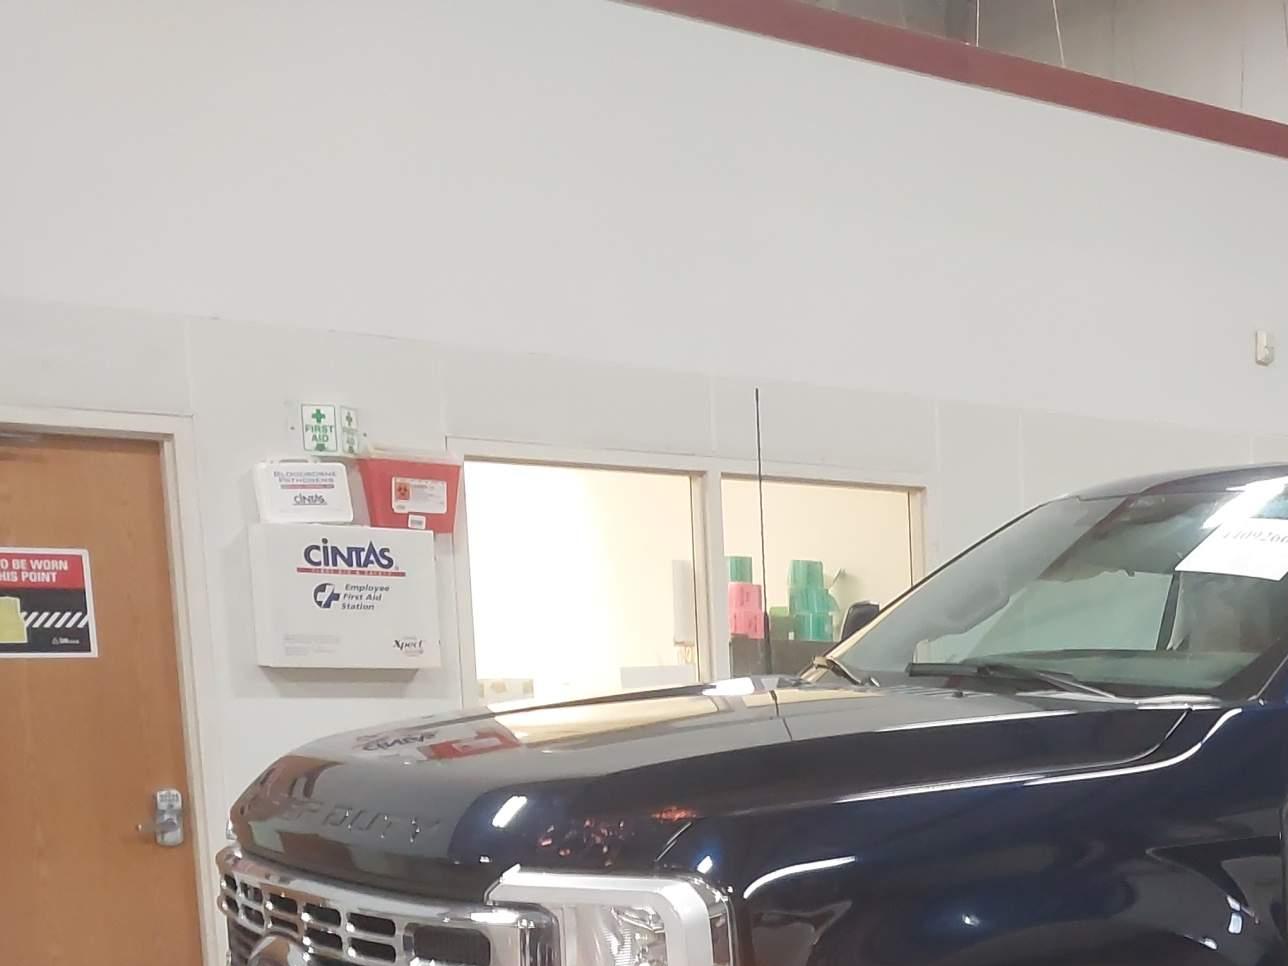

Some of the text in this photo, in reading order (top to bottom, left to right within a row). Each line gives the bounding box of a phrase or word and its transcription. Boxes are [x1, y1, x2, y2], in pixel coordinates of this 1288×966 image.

[305, 424, 333, 433] FIRST
[311, 434, 329, 442] AID
[12, 559, 27, 570] BE
[30, 559, 68, 571] WORN
[21, 571, 57, 582] POINT
[345, 584, 390, 593] Employee
[343, 593, 382, 601] First Aid
[341, 602, 375, 610] Station
